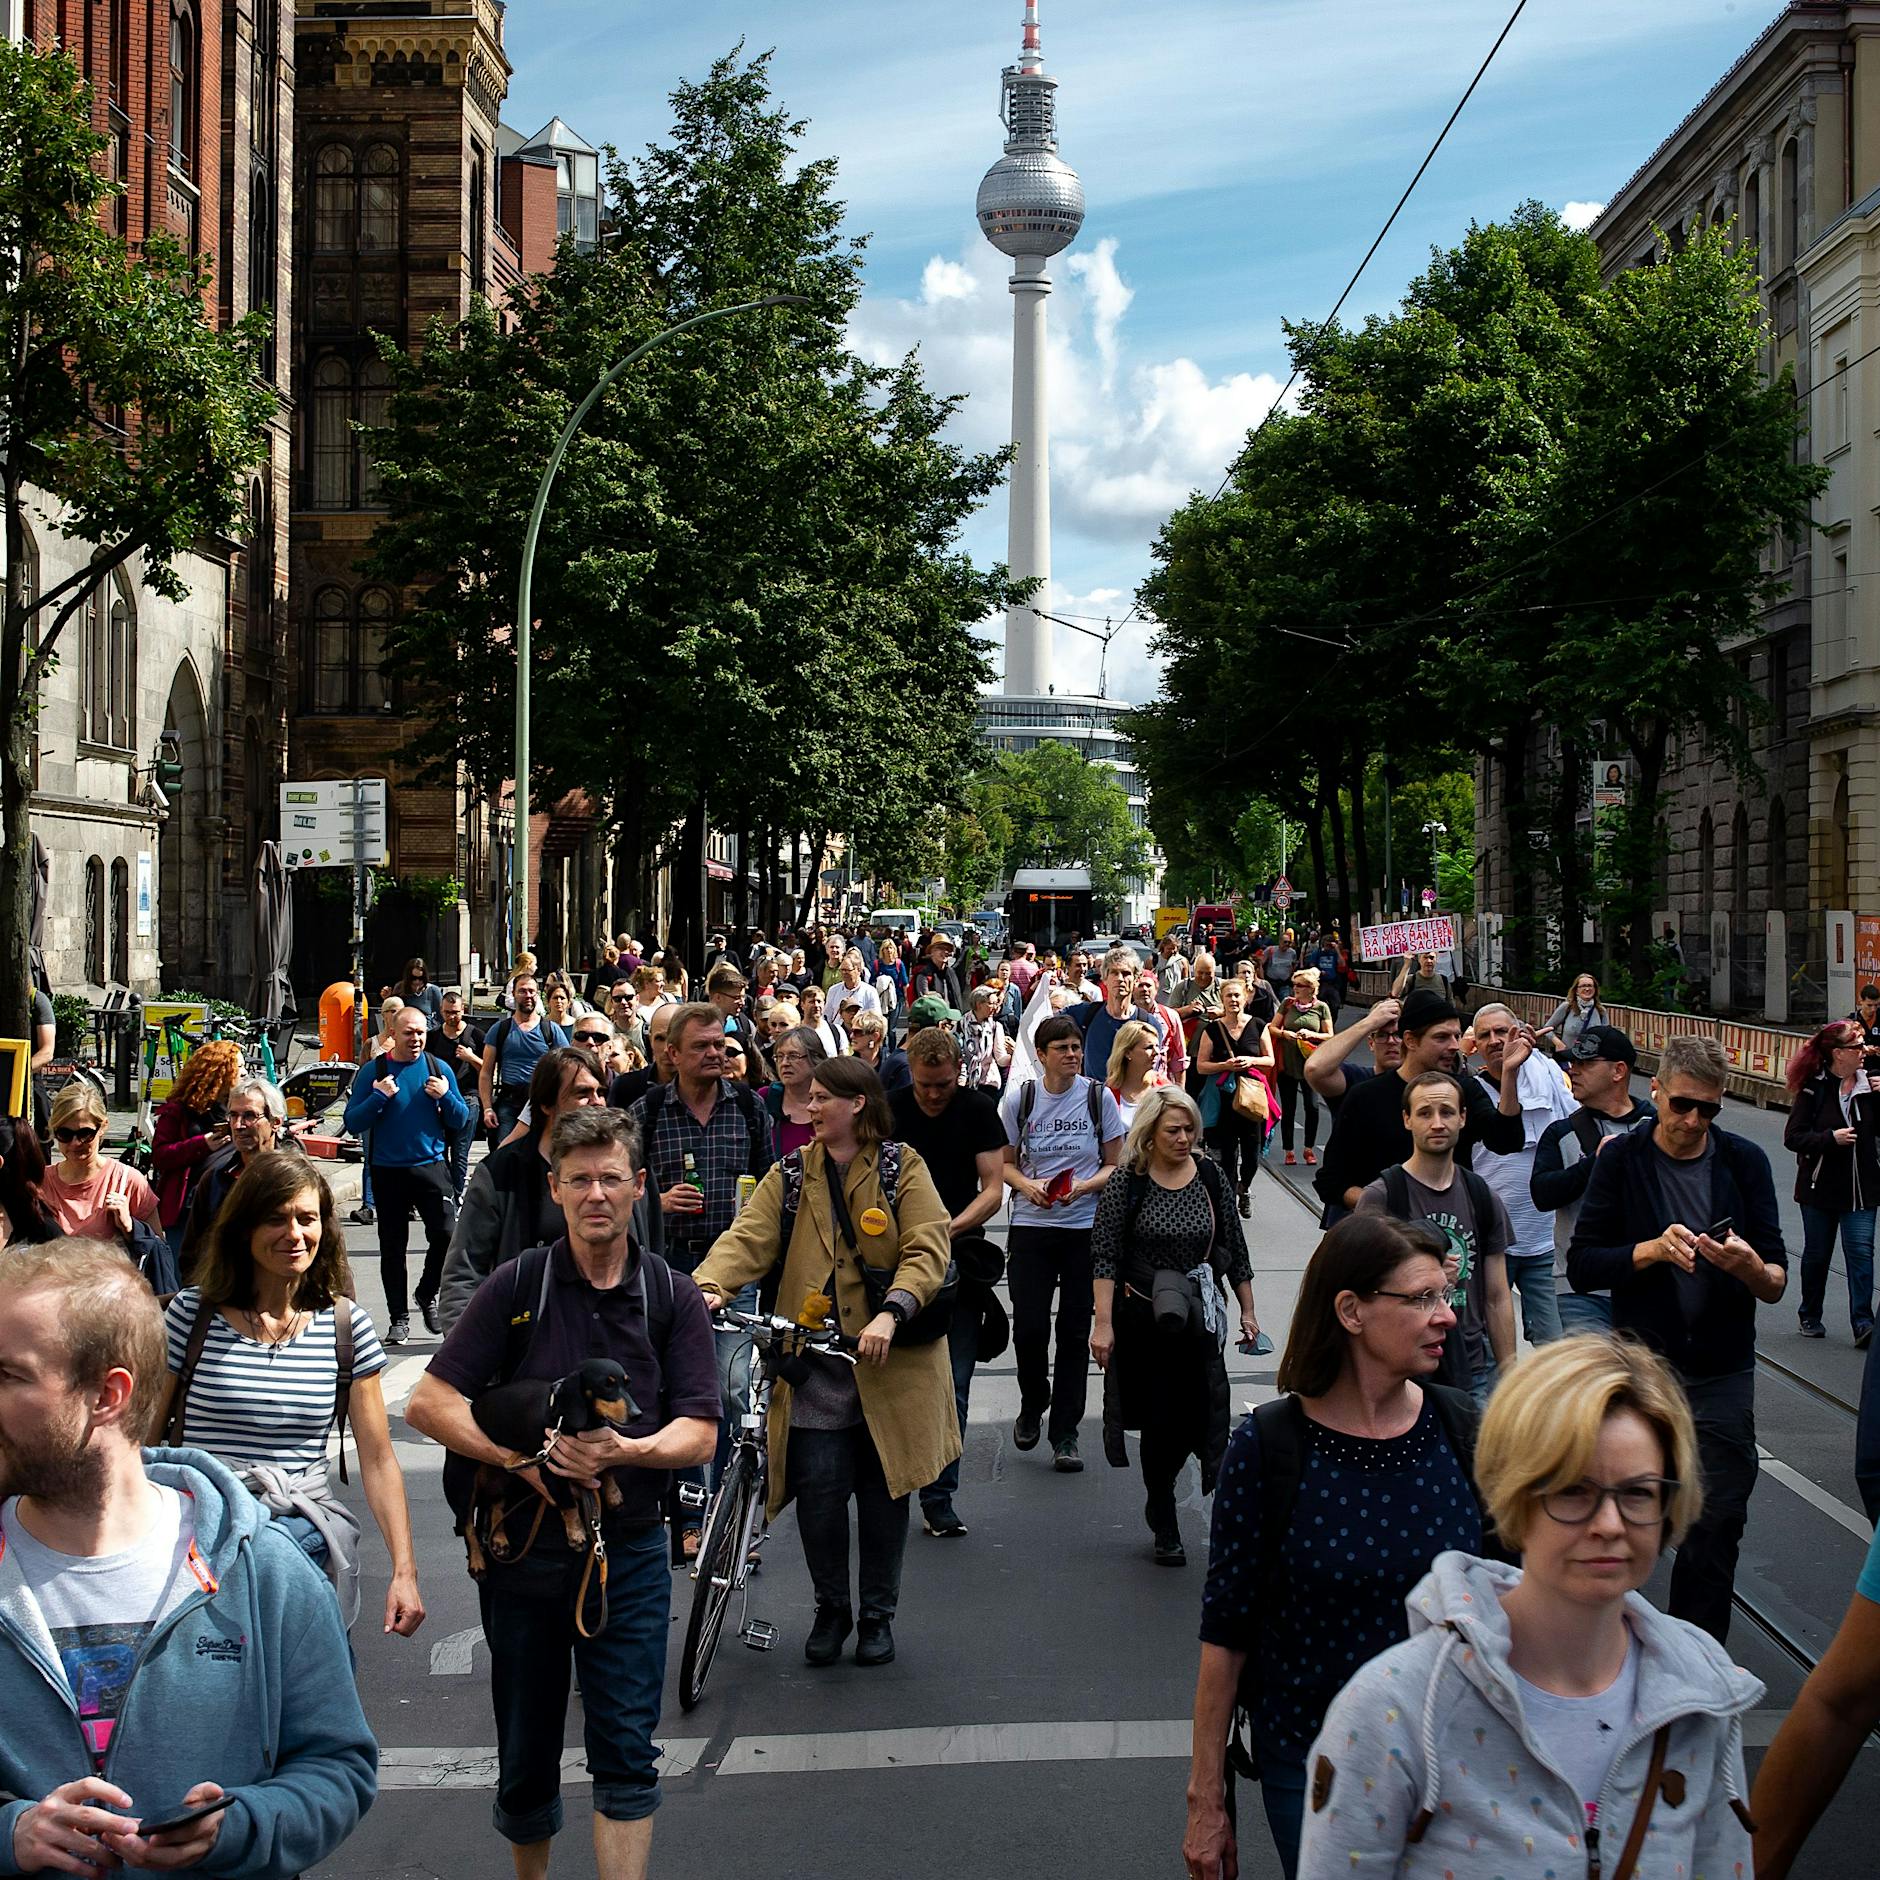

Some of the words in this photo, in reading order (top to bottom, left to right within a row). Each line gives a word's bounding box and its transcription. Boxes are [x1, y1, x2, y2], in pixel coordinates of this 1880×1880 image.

[1362, 928, 1378, 940] ES
[1383, 924, 1405, 937] GIBT
[1365, 938, 1378, 948] DA
[1382, 933, 1407, 946] MUSS
[1409, 930, 1429, 942] MAN
[1432, 926, 1453, 939] EBEN
[1365, 947, 1384, 958] MAL
[1386, 942, 1409, 956] NEIN
